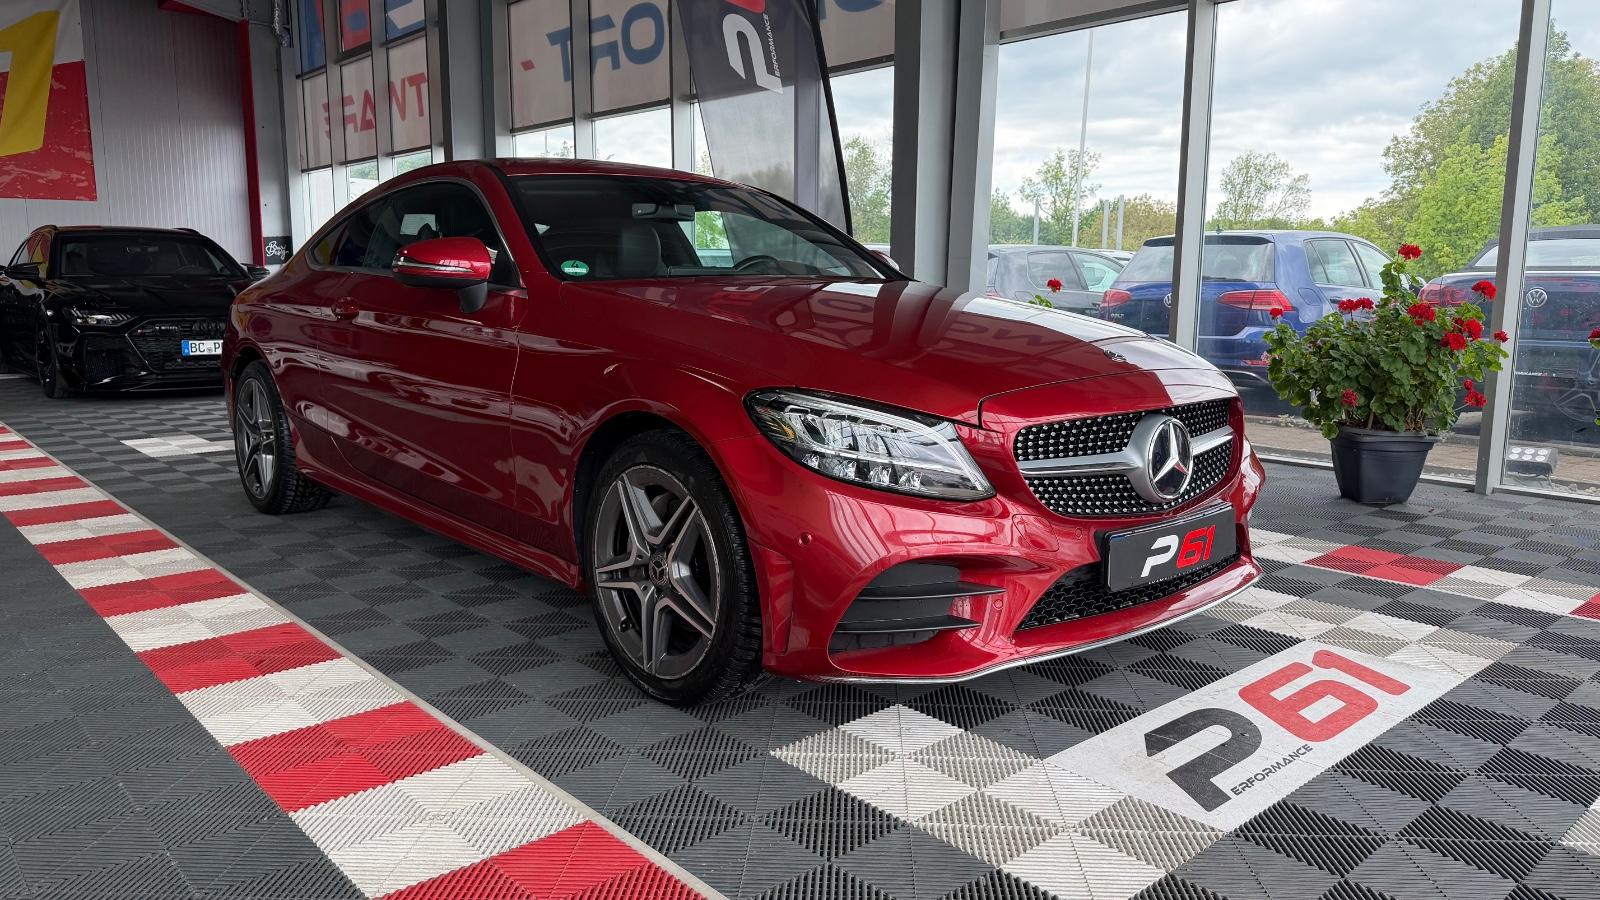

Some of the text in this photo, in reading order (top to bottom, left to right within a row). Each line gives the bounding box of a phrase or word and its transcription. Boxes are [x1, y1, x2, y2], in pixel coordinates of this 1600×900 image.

[720, 0, 784, 94] P
[190, 342, 223, 353] BC P
[1140, 524, 1216, 578] P61
[1143, 649, 1411, 813] P61
[1230, 743, 1314, 797] ERFORMANCE
